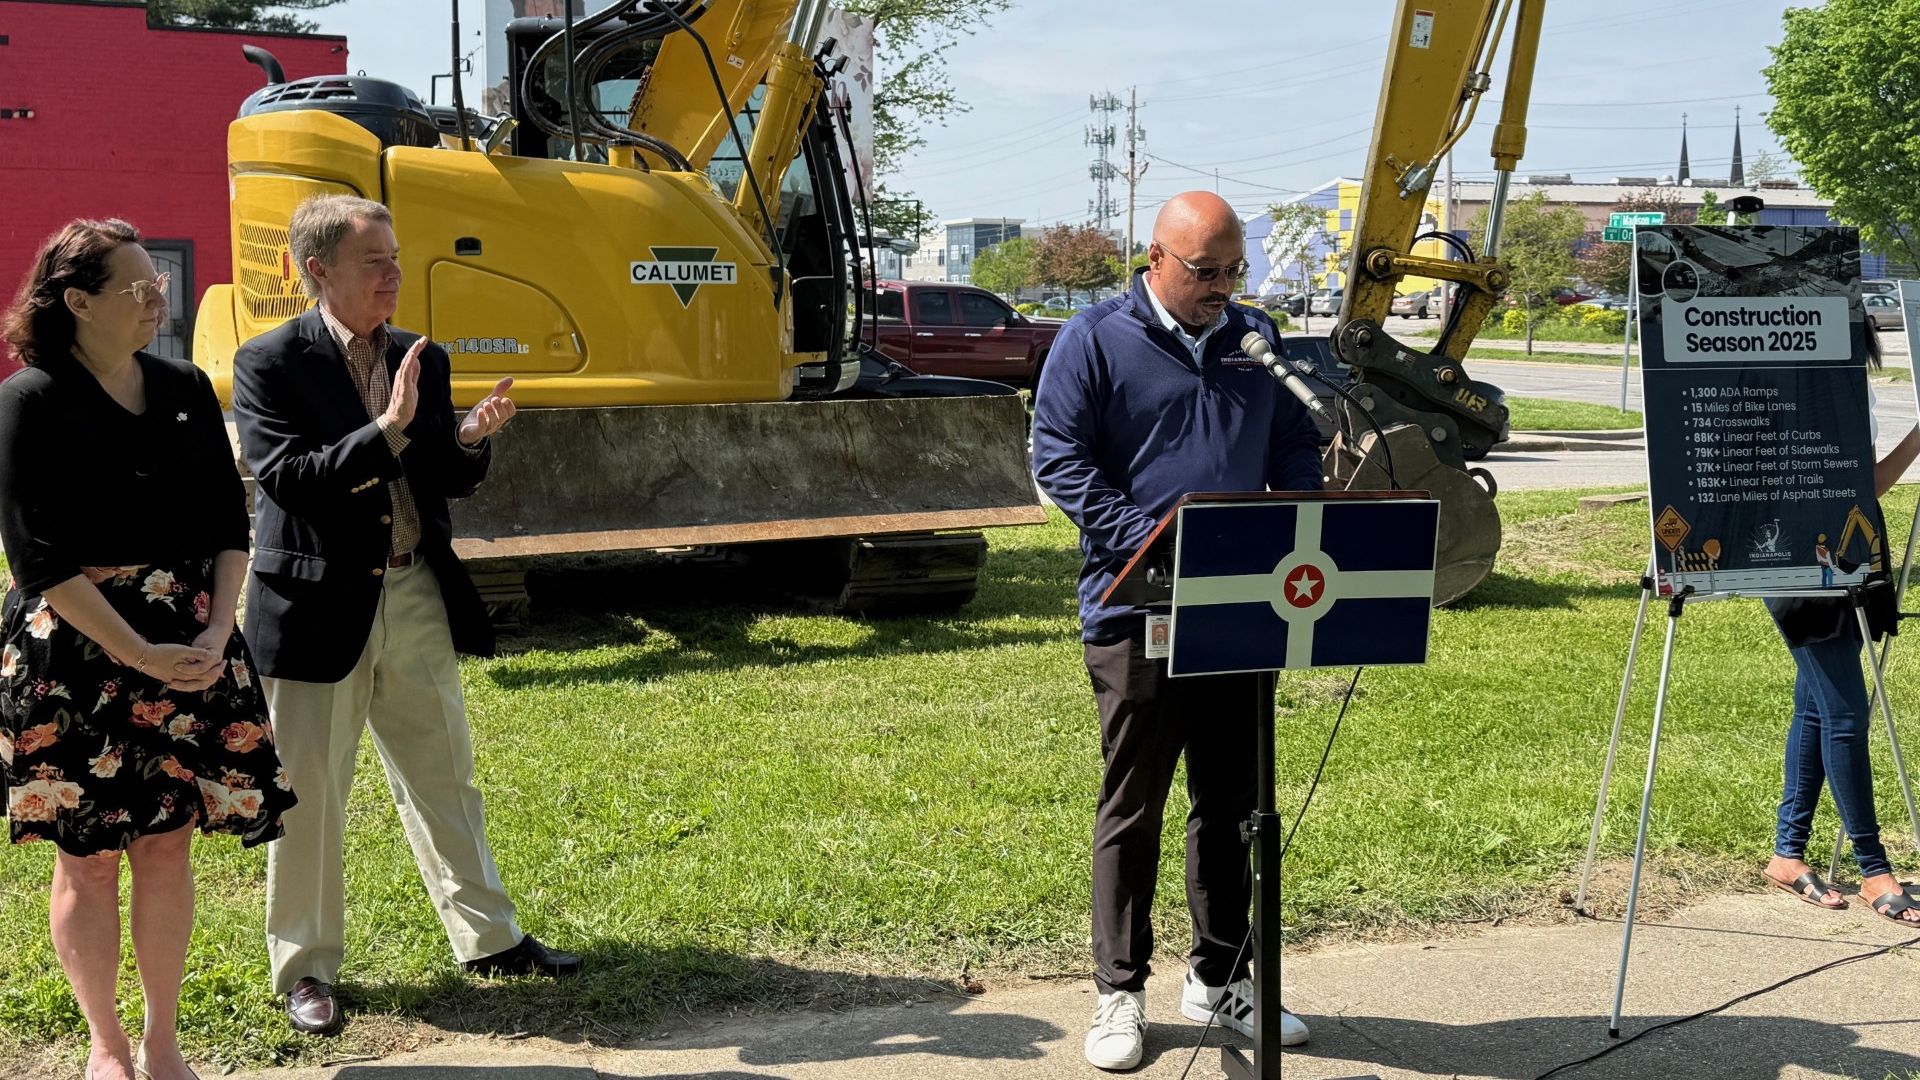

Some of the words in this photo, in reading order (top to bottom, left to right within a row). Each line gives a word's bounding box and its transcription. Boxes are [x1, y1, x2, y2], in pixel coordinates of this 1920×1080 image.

[1622, 214, 1650, 226] Madison
[632, 264, 735, 281] CALUMET
[1684, 304, 1822, 327] Construction
[1686, 332, 1765, 353] Season
[1767, 330, 1817, 352] 2025
[1690, 387, 1717, 399] 1,300
[1720, 387, 1741, 397] ADA
[1743, 386, 1779, 400] Ramps
[1691, 402, 1703, 413] 15
[1704, 402, 1730, 413] Miles
[1732, 401, 1743, 412] of
[1745, 401, 1765, 412] Bike
[1767, 401, 1797, 411] Lanes
[1692, 417, 1712, 428] 734
[1713, 415, 1770, 427] Crosswalks
[1694, 432, 1721, 443] 88K+
[1723, 431, 1754, 442] Linear
[1756, 431, 1778, 441] Feet
[1779, 430, 1790, 440] of
[1791, 429, 1822, 440] Curbs
[1694, 447, 1721, 458] 79K+
[1722, 446, 1753, 457] Linear
[1755, 446, 1777, 456] Feet
[1779, 445, 1789, 456] of
[1791, 443, 1840, 455] Sidewalks
[1696, 462, 1721, 473] 37K+
[1723, 461, 1754, 472] Linear
[1756, 460, 1778, 471] Feet
[1779, 459, 1789, 470] of
[1791, 460, 1822, 470] Storm
[1823, 459, 1859, 469] Sewers
[1696, 477, 1728, 488] 163K+
[1729, 476, 1760, 487] Linear
[1762, 475, 1783, 486] Feet
[1785, 474, 1796, 485] of
[1797, 474, 1824, 484] Trails
[1697, 492, 1715, 503] 132
[1716, 492, 1740, 503] Lane
[1742, 491, 1768, 501] Miles
[1770, 490, 1780, 501] of
[1782, 489, 1820, 503] Asphalt
[1822, 488, 1857, 499] Streets
[1748, 551, 1792, 559] INDIANAPOLIS
